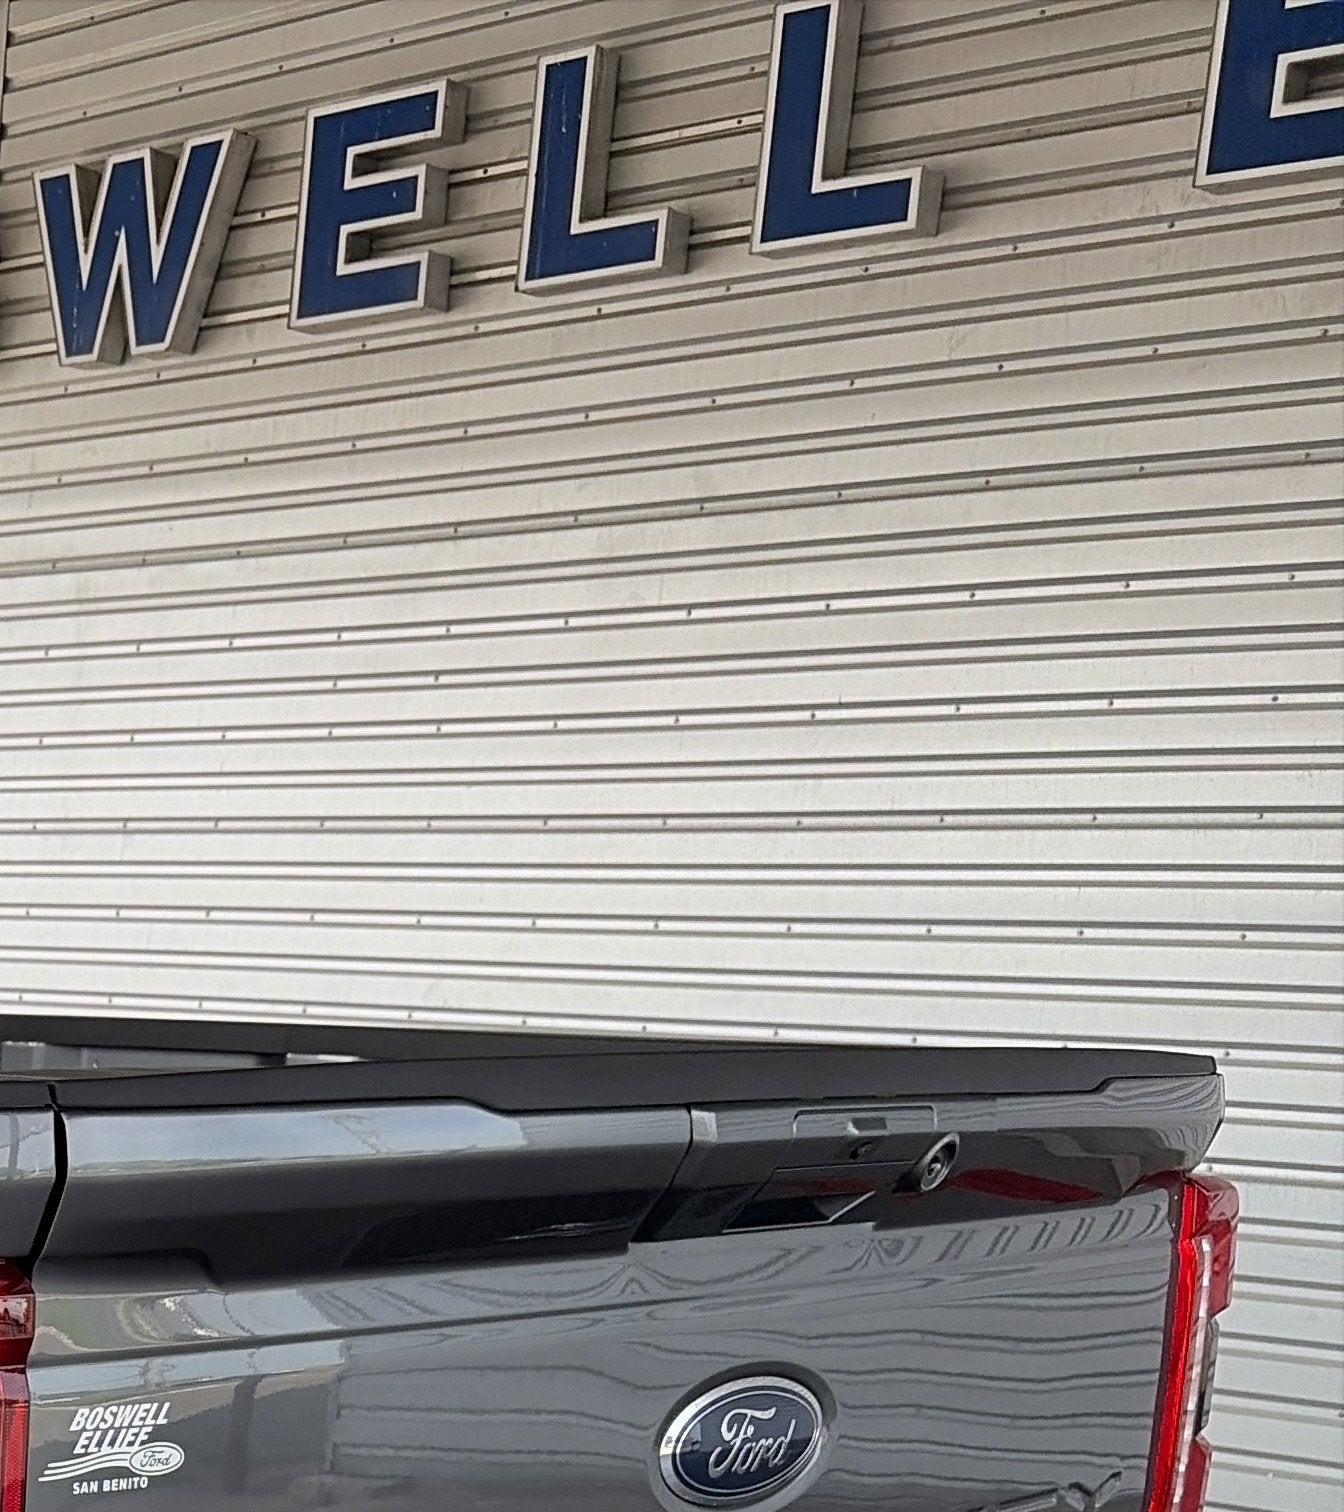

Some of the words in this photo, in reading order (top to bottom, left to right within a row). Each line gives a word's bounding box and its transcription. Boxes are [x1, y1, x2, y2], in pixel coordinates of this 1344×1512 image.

[69, 1402, 171, 1431] BOSWELL
[73, 1426, 153, 1454] ELLIFF
[708, 1407, 796, 1478] Ford
[140, 1450, 172, 1467] Ford
[72, 1479, 98, 1495] SAN
[102, 1476, 148, 1492] BENITO
